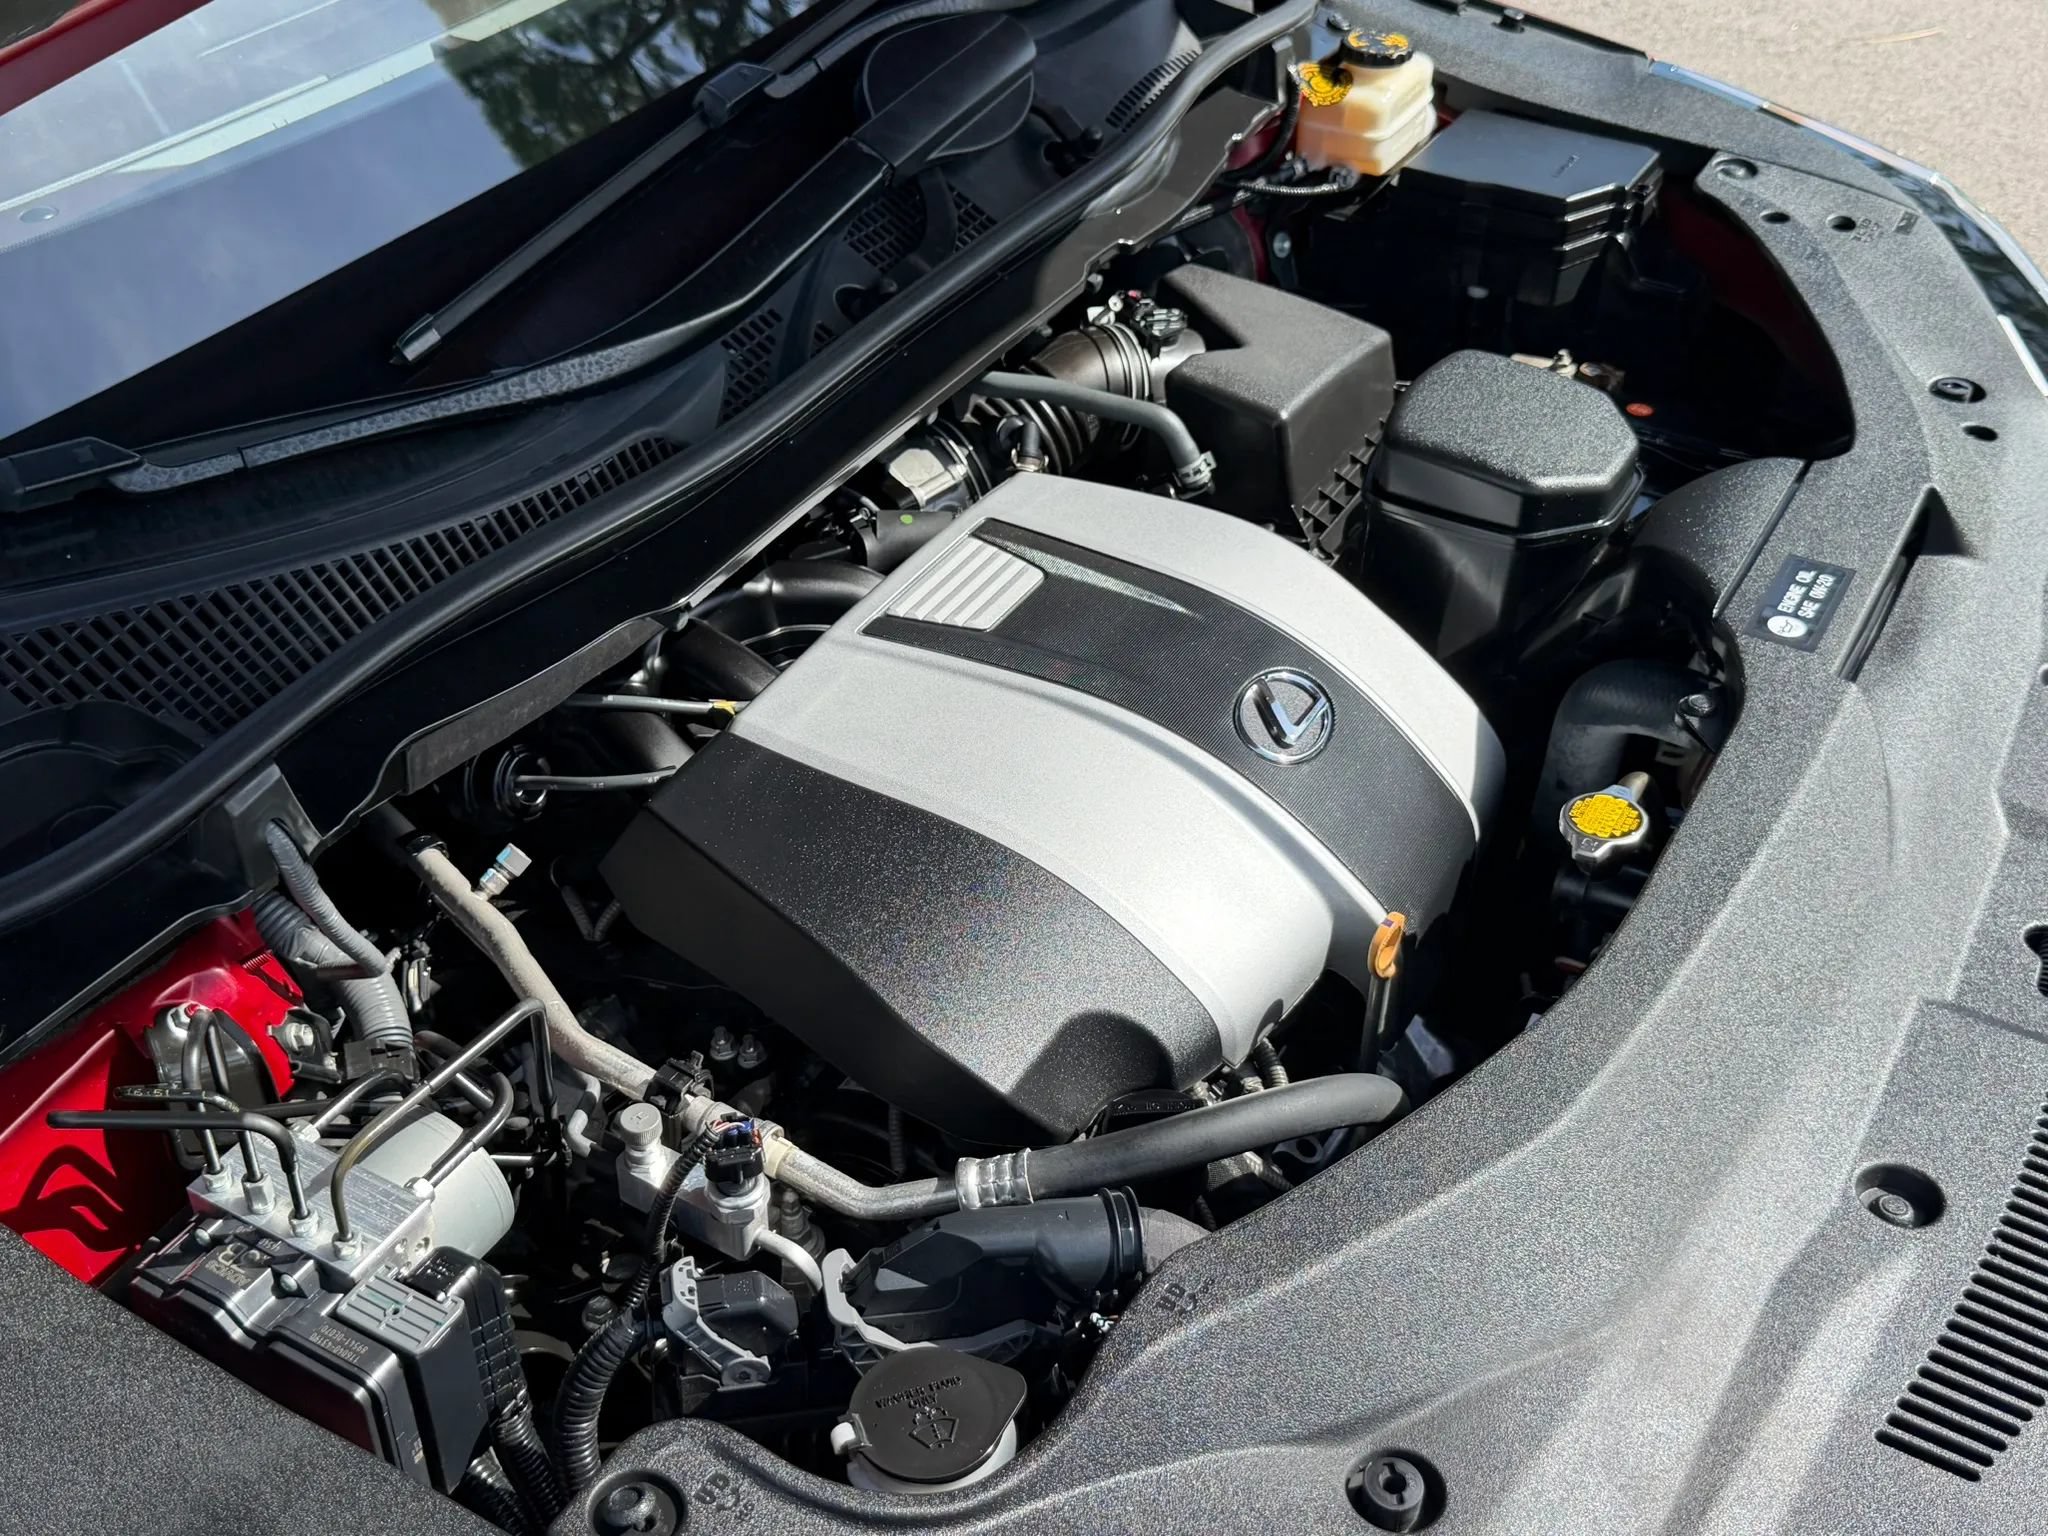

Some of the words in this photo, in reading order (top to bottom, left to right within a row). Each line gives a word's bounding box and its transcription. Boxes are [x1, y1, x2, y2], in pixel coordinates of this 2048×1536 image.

[1777, 583, 1808, 613] ENGINE
[1797, 600, 1821, 618] SAE
[875, 1387, 927, 1408] WASHER
[928, 1376, 962, 1391] FLUID
[908, 1393, 938, 1409] ONLY
